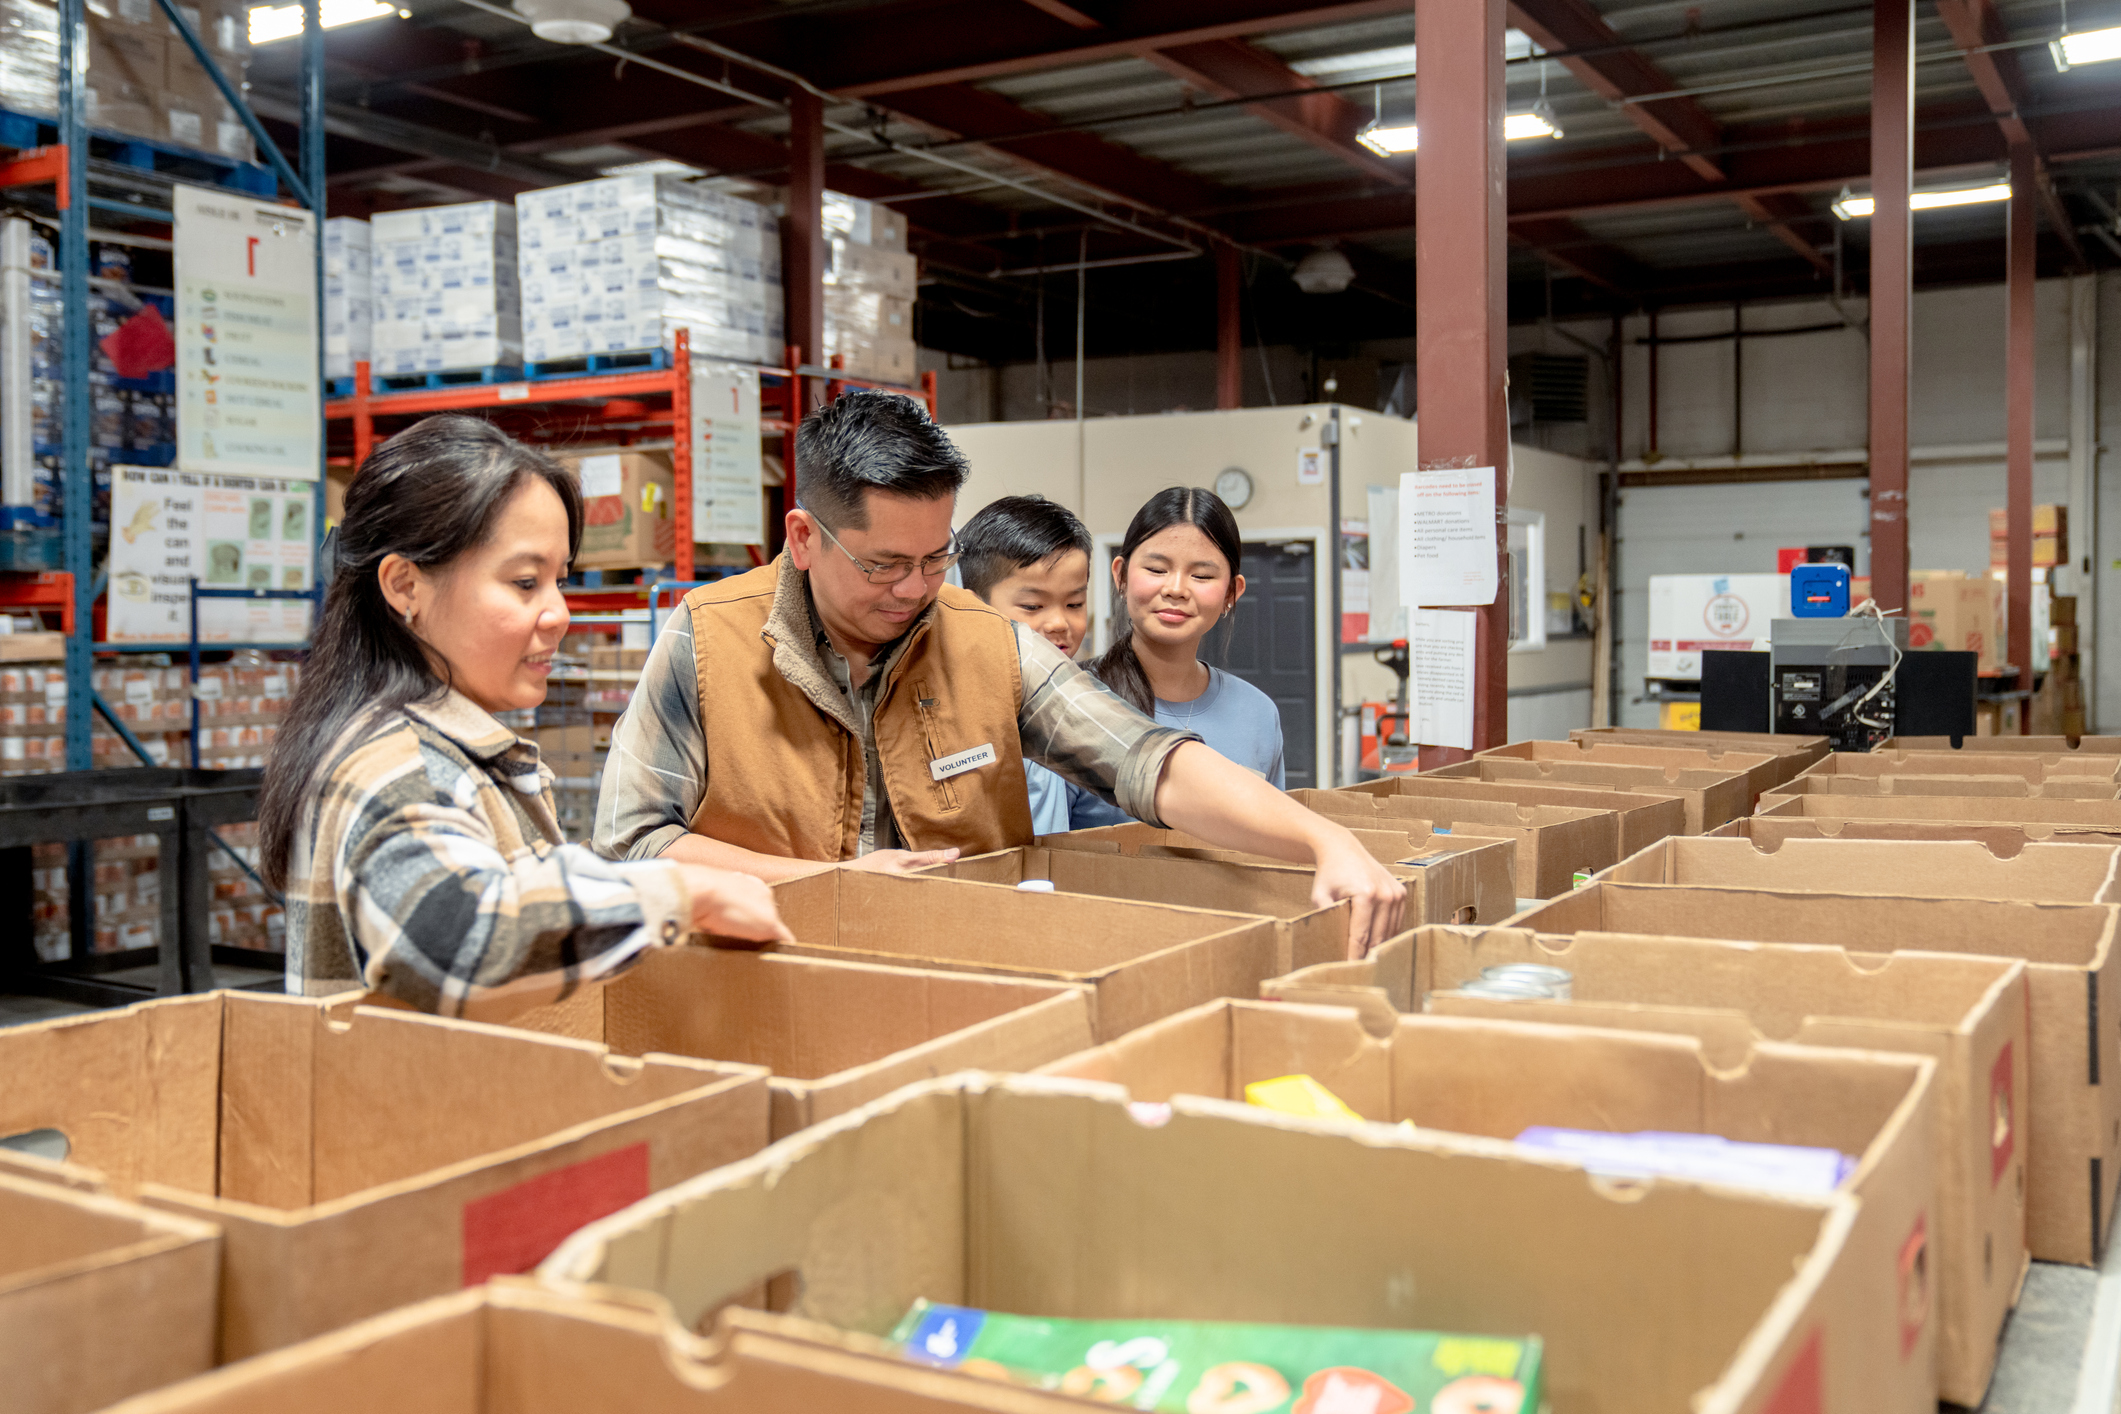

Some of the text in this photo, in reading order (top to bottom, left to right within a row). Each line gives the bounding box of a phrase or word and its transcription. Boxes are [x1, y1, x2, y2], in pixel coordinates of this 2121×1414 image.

[164, 498, 192, 511] Feel
[166, 517, 188, 529] the
[164, 537, 189, 548] can
[165, 555, 189, 567] and
[939, 751, 989, 773] VOLUNTEER
